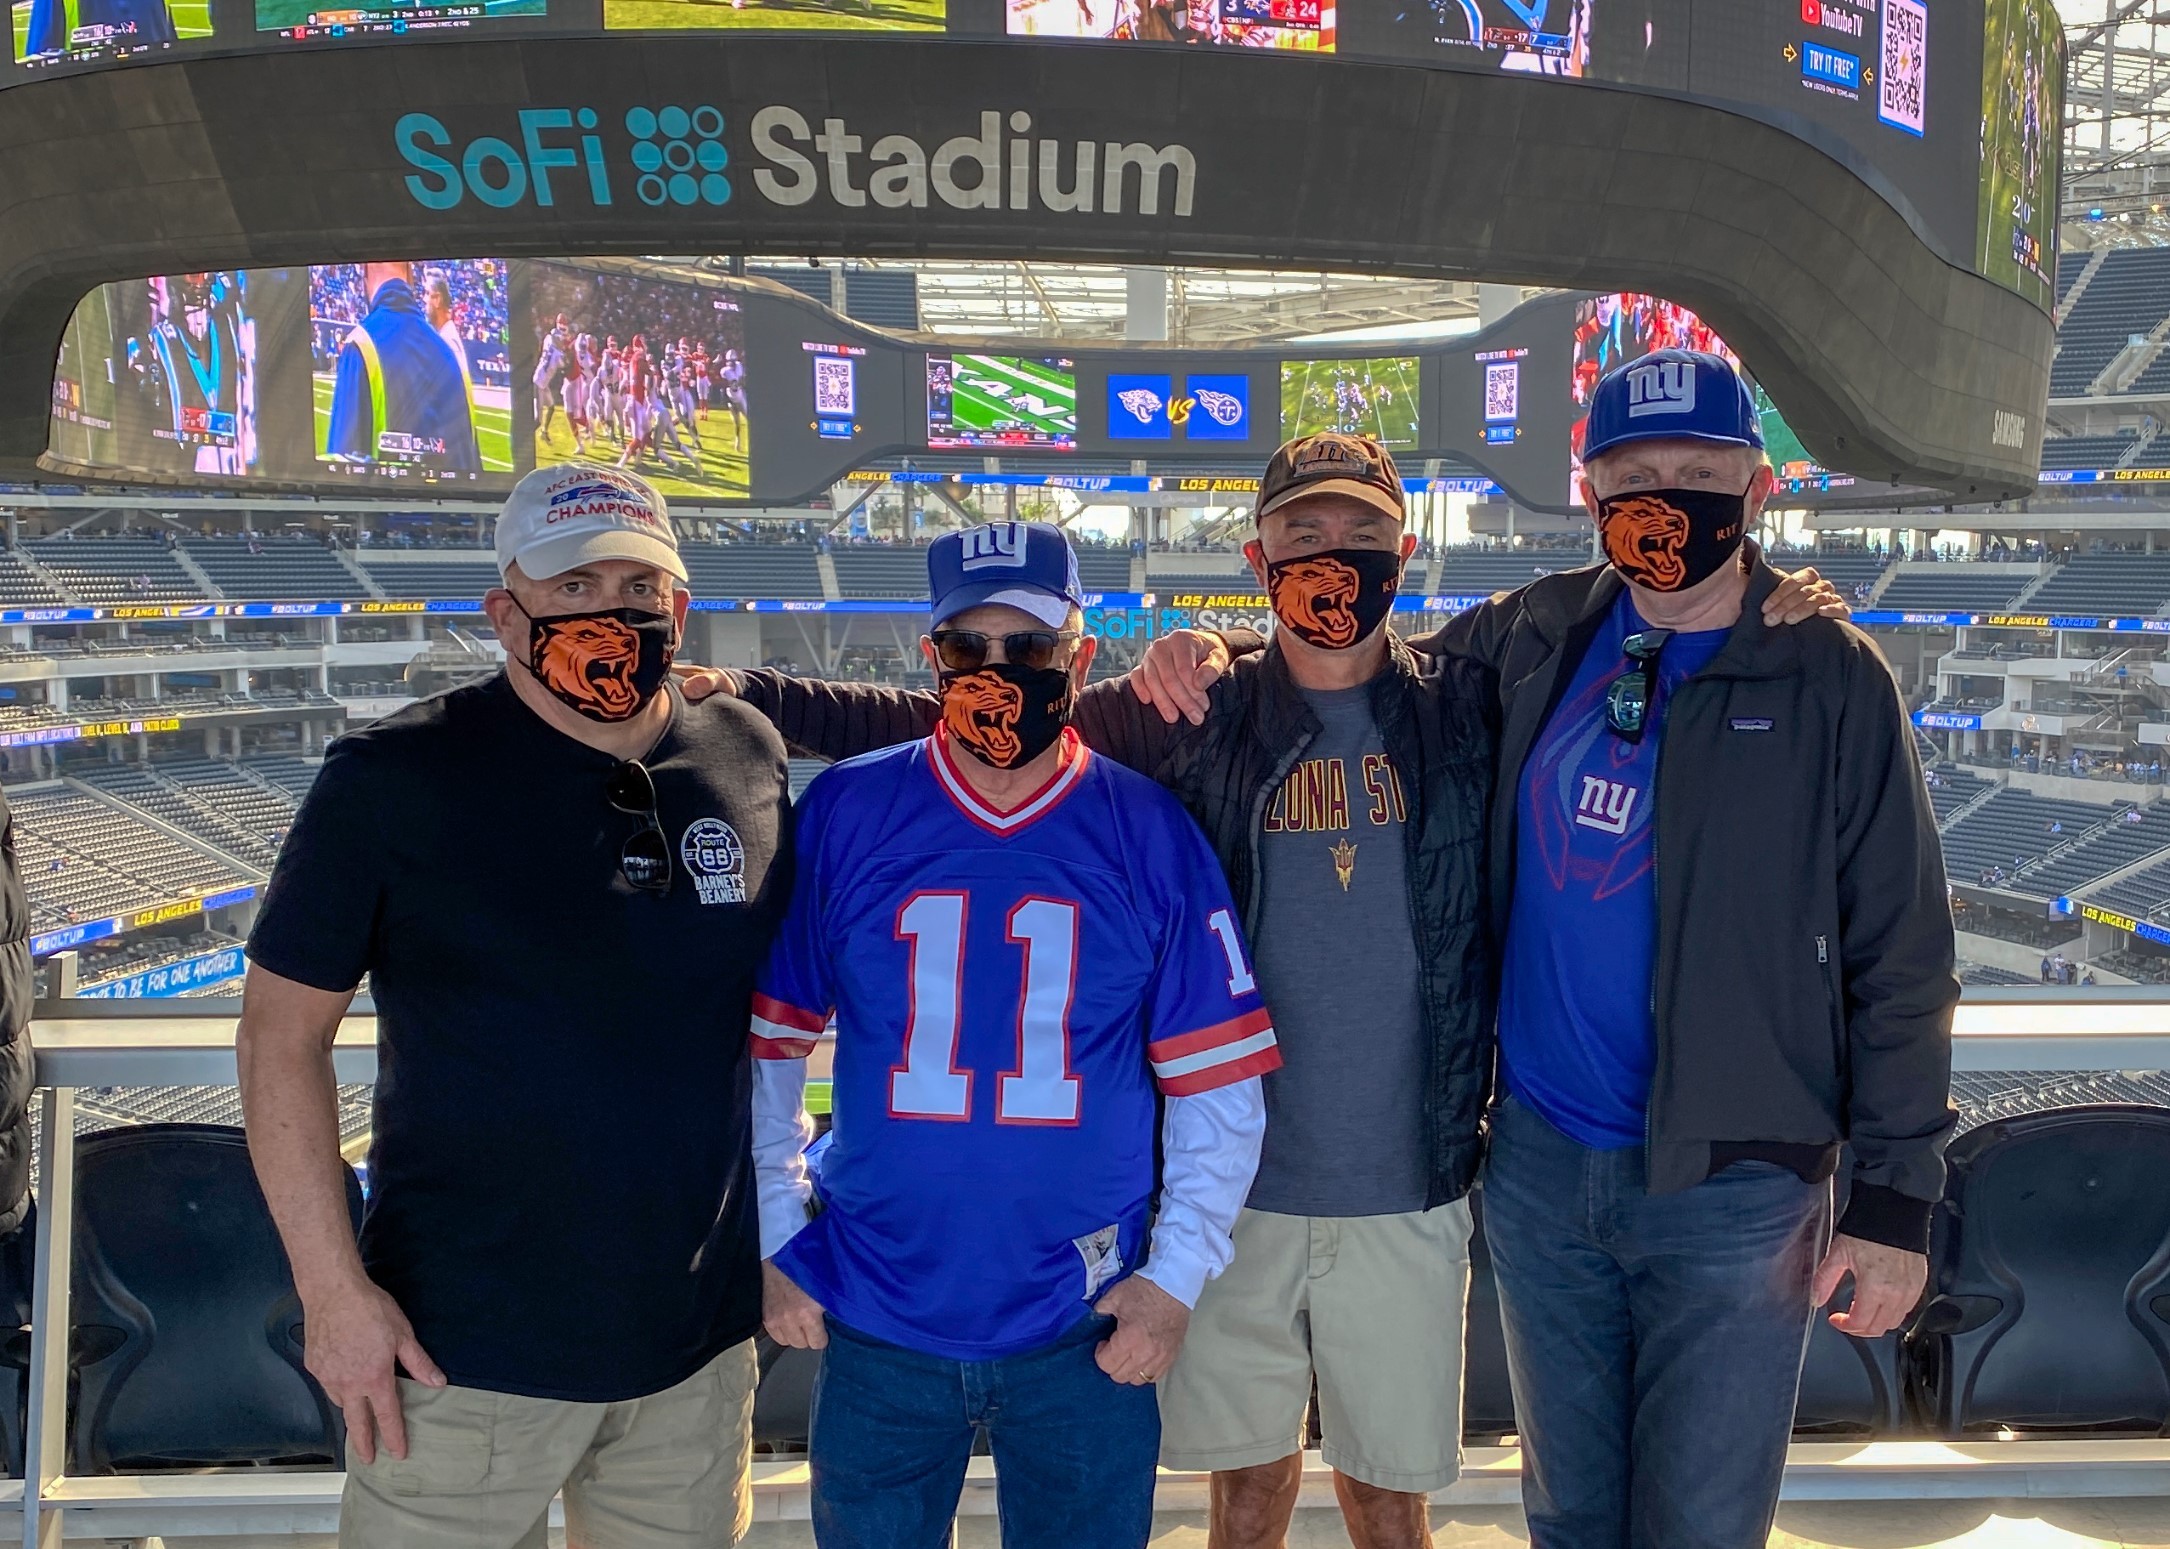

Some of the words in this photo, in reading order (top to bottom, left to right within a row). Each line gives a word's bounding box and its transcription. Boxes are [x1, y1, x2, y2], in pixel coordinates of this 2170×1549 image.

[1300, 1, 1317, 18] 24
[1820, 3, 1853, 33] YouTube
[1809, 49, 1824, 72] TRY
[1824, 53, 1833, 74] IT
[395, 107, 612, 210] SoFi
[751, 106, 1197, 217] Stadium
[1166, 397, 1197, 425] VS
[1992, 409, 2025, 449] SAMSUNG
[544, 480, 566, 495] AFC
[568, 472, 598, 485] EAST
[847, 472, 891, 481] ANGELES
[1179, 479, 1208, 491] LOS
[2114, 471, 2133, 480] LOS
[546, 502, 656, 526] CHAMPIONS
[361, 602, 380, 612] LOS
[381, 602, 425, 612] ANGELES
[1172, 595, 1202, 607] LOS
[1204, 595, 1272, 609] ANGELES
[113, 608, 132, 618] LOS
[1988, 615, 2006, 626] LOS
[2006, 616, 2048, 627] ANGELES
[2048, 617, 2098, 628] CHARGERS
[1084, 607, 1153, 640] SoFi
[701, 838, 725, 847] ROUTE
[701, 848, 729, 866] 66
[694, 874, 746, 890] BARNEY'S
[698, 888, 747, 905] BEANERY
[133, 913, 155, 927] LOS
[155, 900, 202, 924] ANGELES
[2081, 905, 2099, 920] LOS
[2098, 911, 2137, 933] ANGELES
[130, 976, 143, 998] BE
[147, 970, 167, 993] FOR
[170, 963, 190, 986] ONE
[193, 952, 238, 979] ANOTHER
[887, 889, 1083, 1127] 11
